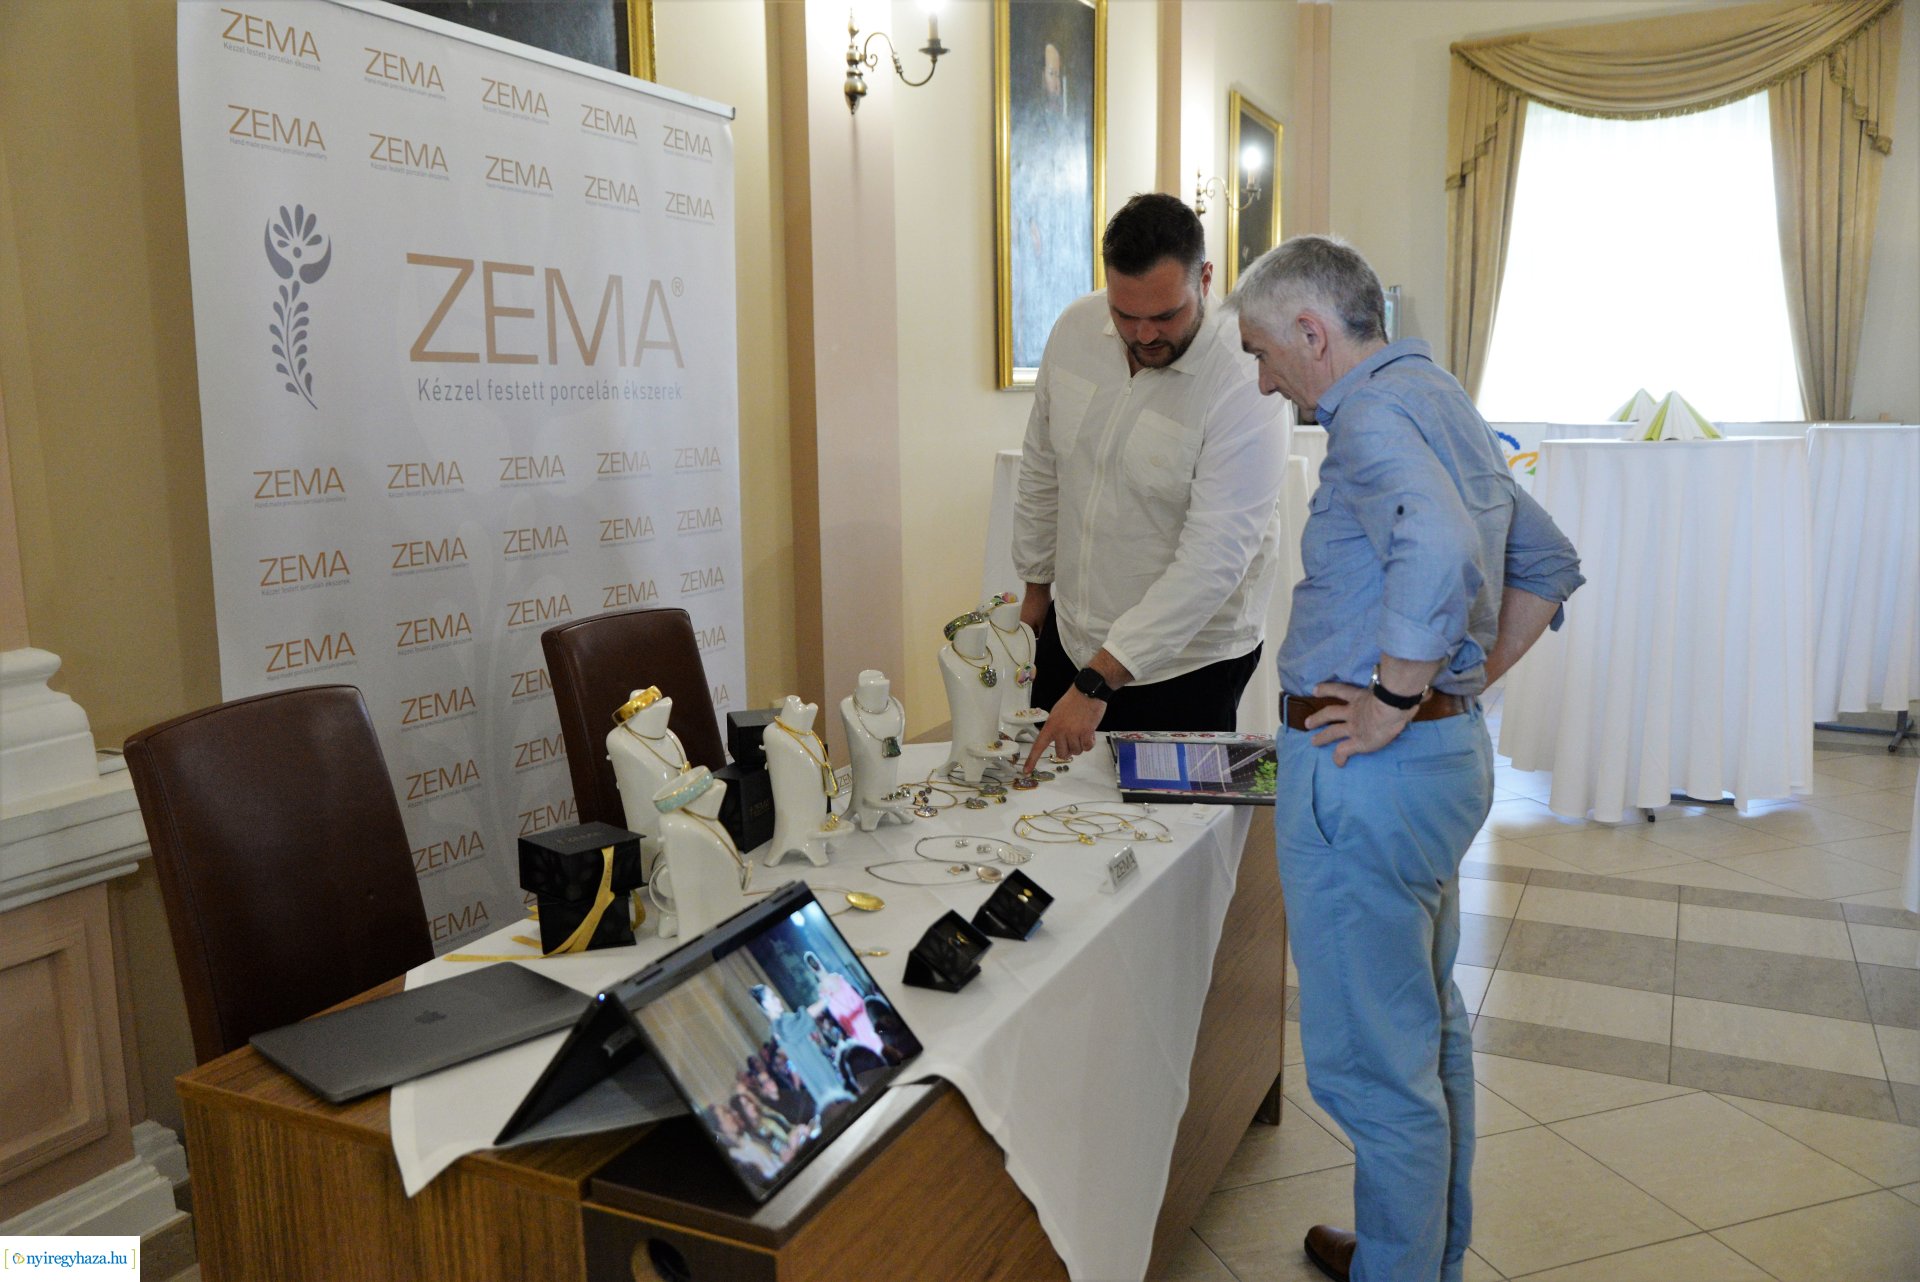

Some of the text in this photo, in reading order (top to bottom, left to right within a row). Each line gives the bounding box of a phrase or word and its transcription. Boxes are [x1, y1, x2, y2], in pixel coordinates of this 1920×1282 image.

[220, 8, 320, 62] ZEMA
[364, 47, 444, 91] ZEMA
[481, 77, 549, 117] ZEMA
[227, 104, 326, 151] ZEMA
[581, 104, 638, 139] ZEMA
[369, 133, 448, 172] ZEMA
[663, 126, 713, 157] ZEMA
[485, 155, 552, 190] ZEMA
[584, 175, 640, 206] ZEMA
[665, 191, 714, 220] ZEMA
[418, 377, 682, 406] Kézzel festett porcelán ékszerek
[499, 454, 566, 481] ZEMA
[597, 451, 651, 474] ZEMA
[674, 447, 721, 469] ZEMA
[253, 467, 345, 499] ZEMA
[387, 461, 464, 489] ZEMA
[600, 515, 655, 542] ZEMA
[676, 506, 723, 531] ZEMA
[391, 537, 468, 569] ZEMA
[503, 525, 569, 554] ZEMA
[259, 550, 350, 587] ZEMA
[680, 566, 725, 593] ZEMA
[603, 579, 659, 608] ZEMA
[507, 594, 573, 627] ZEMA
[396, 612, 472, 648] ZEMA
[265, 632, 356, 673] ZEMA
[401, 686, 476, 725] ZEMA
[514, 733, 567, 768] ZEM
[406, 759, 481, 800] ZEMA
[411, 830, 485, 874] ZEMA
[428, 901, 489, 941] EMA
